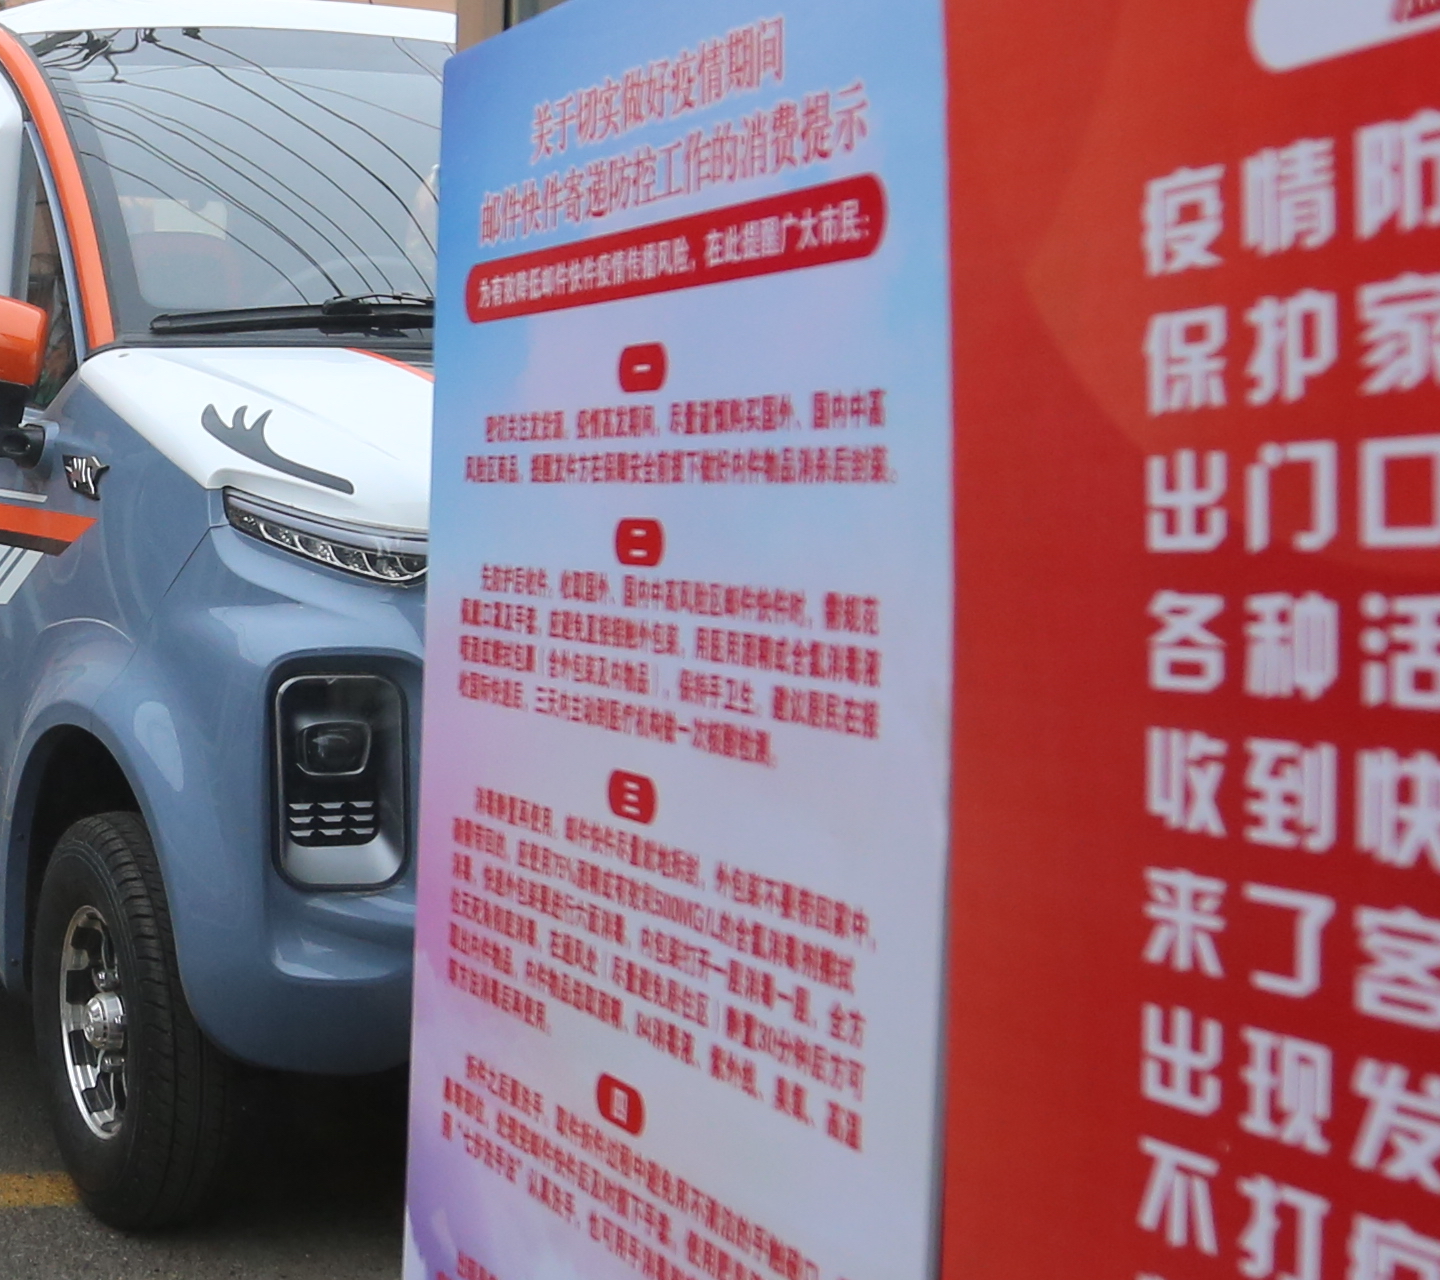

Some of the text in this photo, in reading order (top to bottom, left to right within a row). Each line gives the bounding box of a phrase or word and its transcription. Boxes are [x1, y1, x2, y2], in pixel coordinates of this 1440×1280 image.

[477, 81, 870, 248] 邮件快件寄递防控工作的消费提示
[529, 16, 786, 165] 关于切实做好疫情期间
